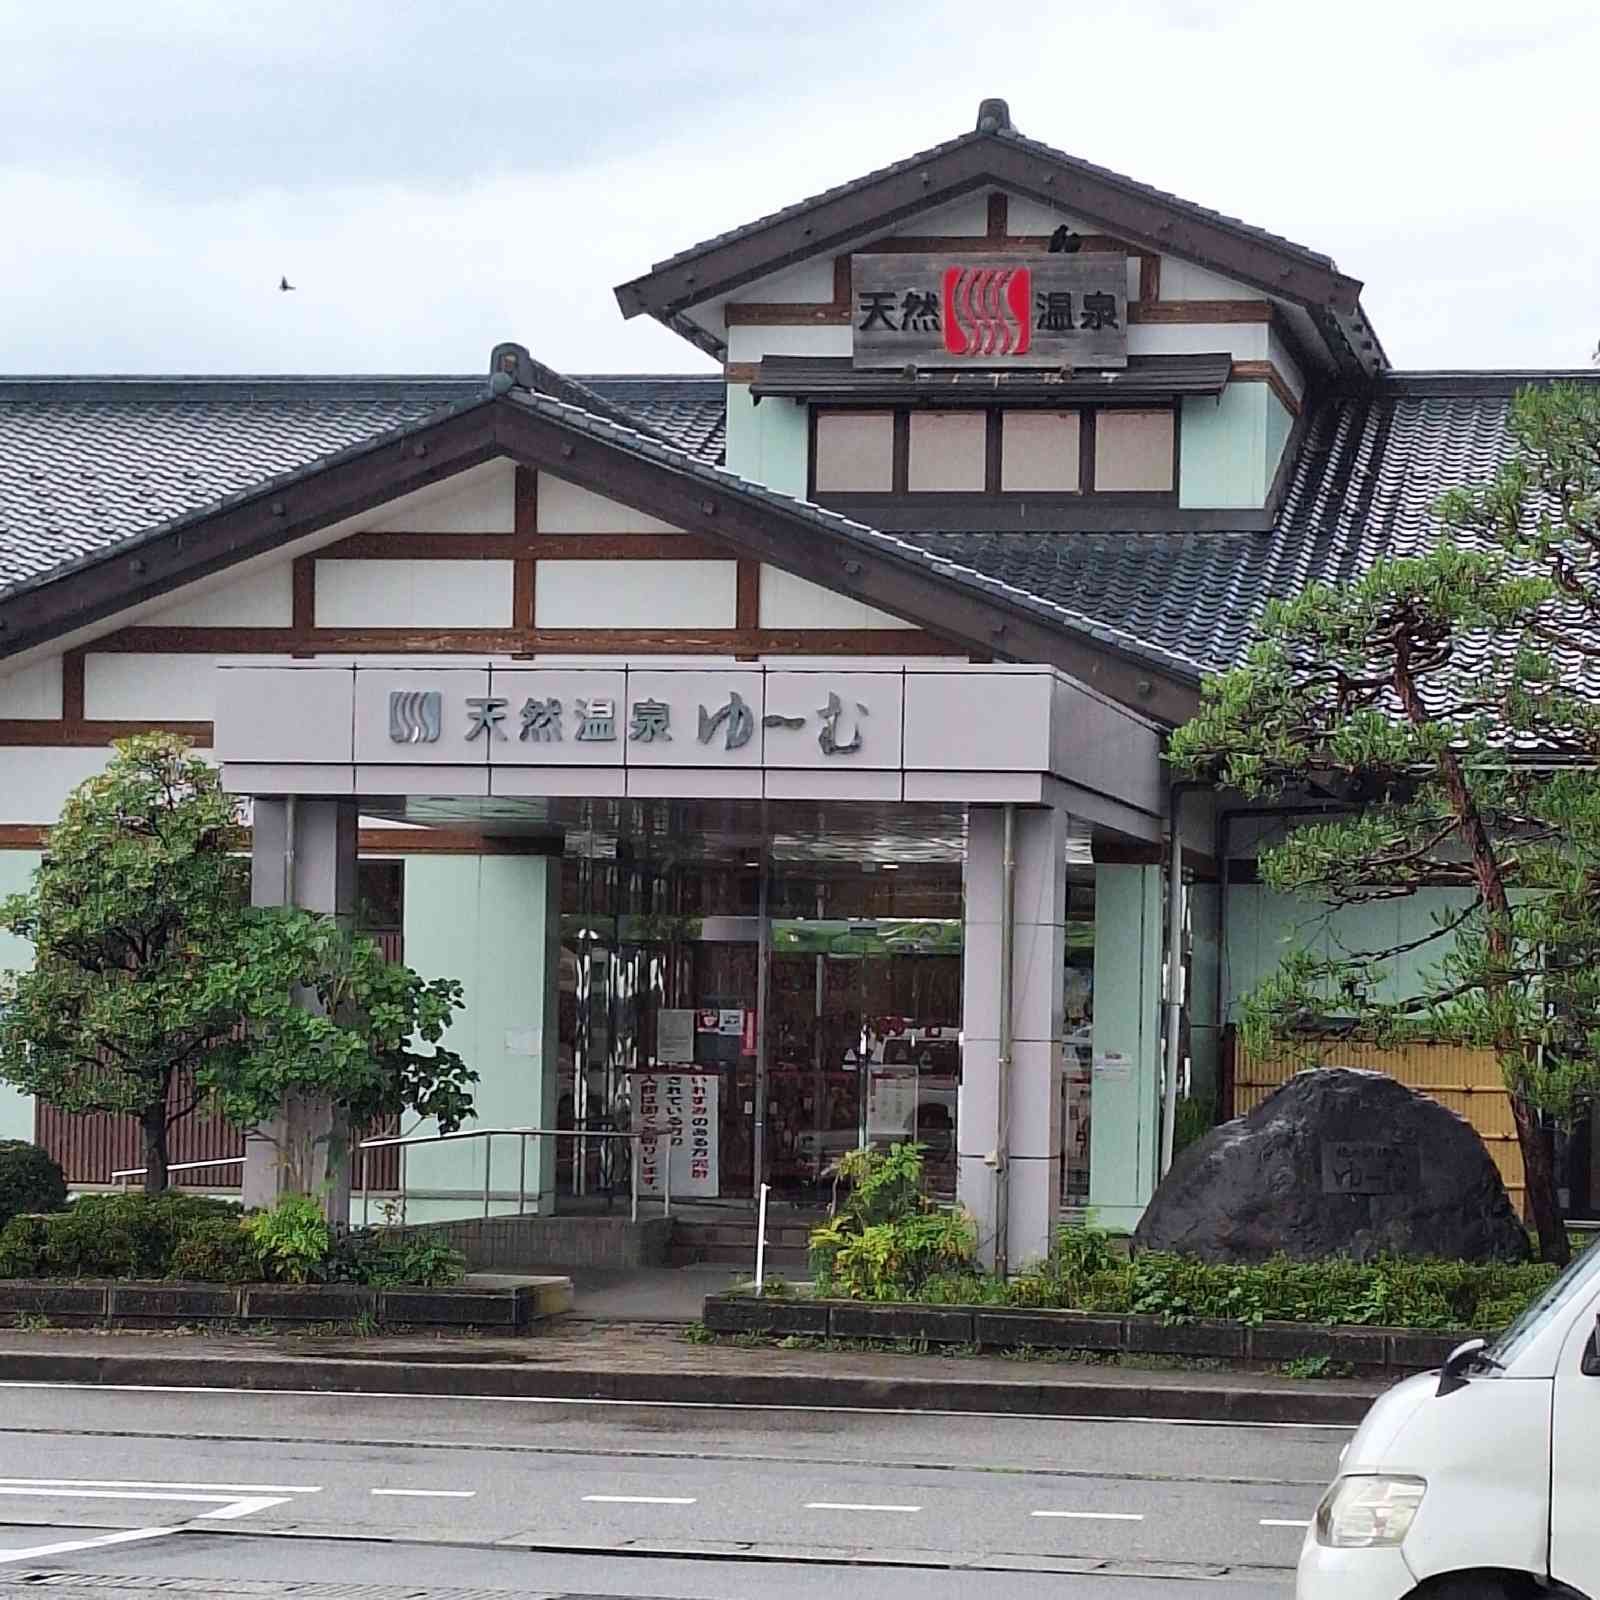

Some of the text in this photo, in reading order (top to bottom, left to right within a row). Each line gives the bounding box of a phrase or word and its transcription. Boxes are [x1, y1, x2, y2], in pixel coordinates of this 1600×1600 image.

[858, 290, 1119, 331] 天然 温泉
[464, 691, 869, 755] 天然温泉 ゆーむ
